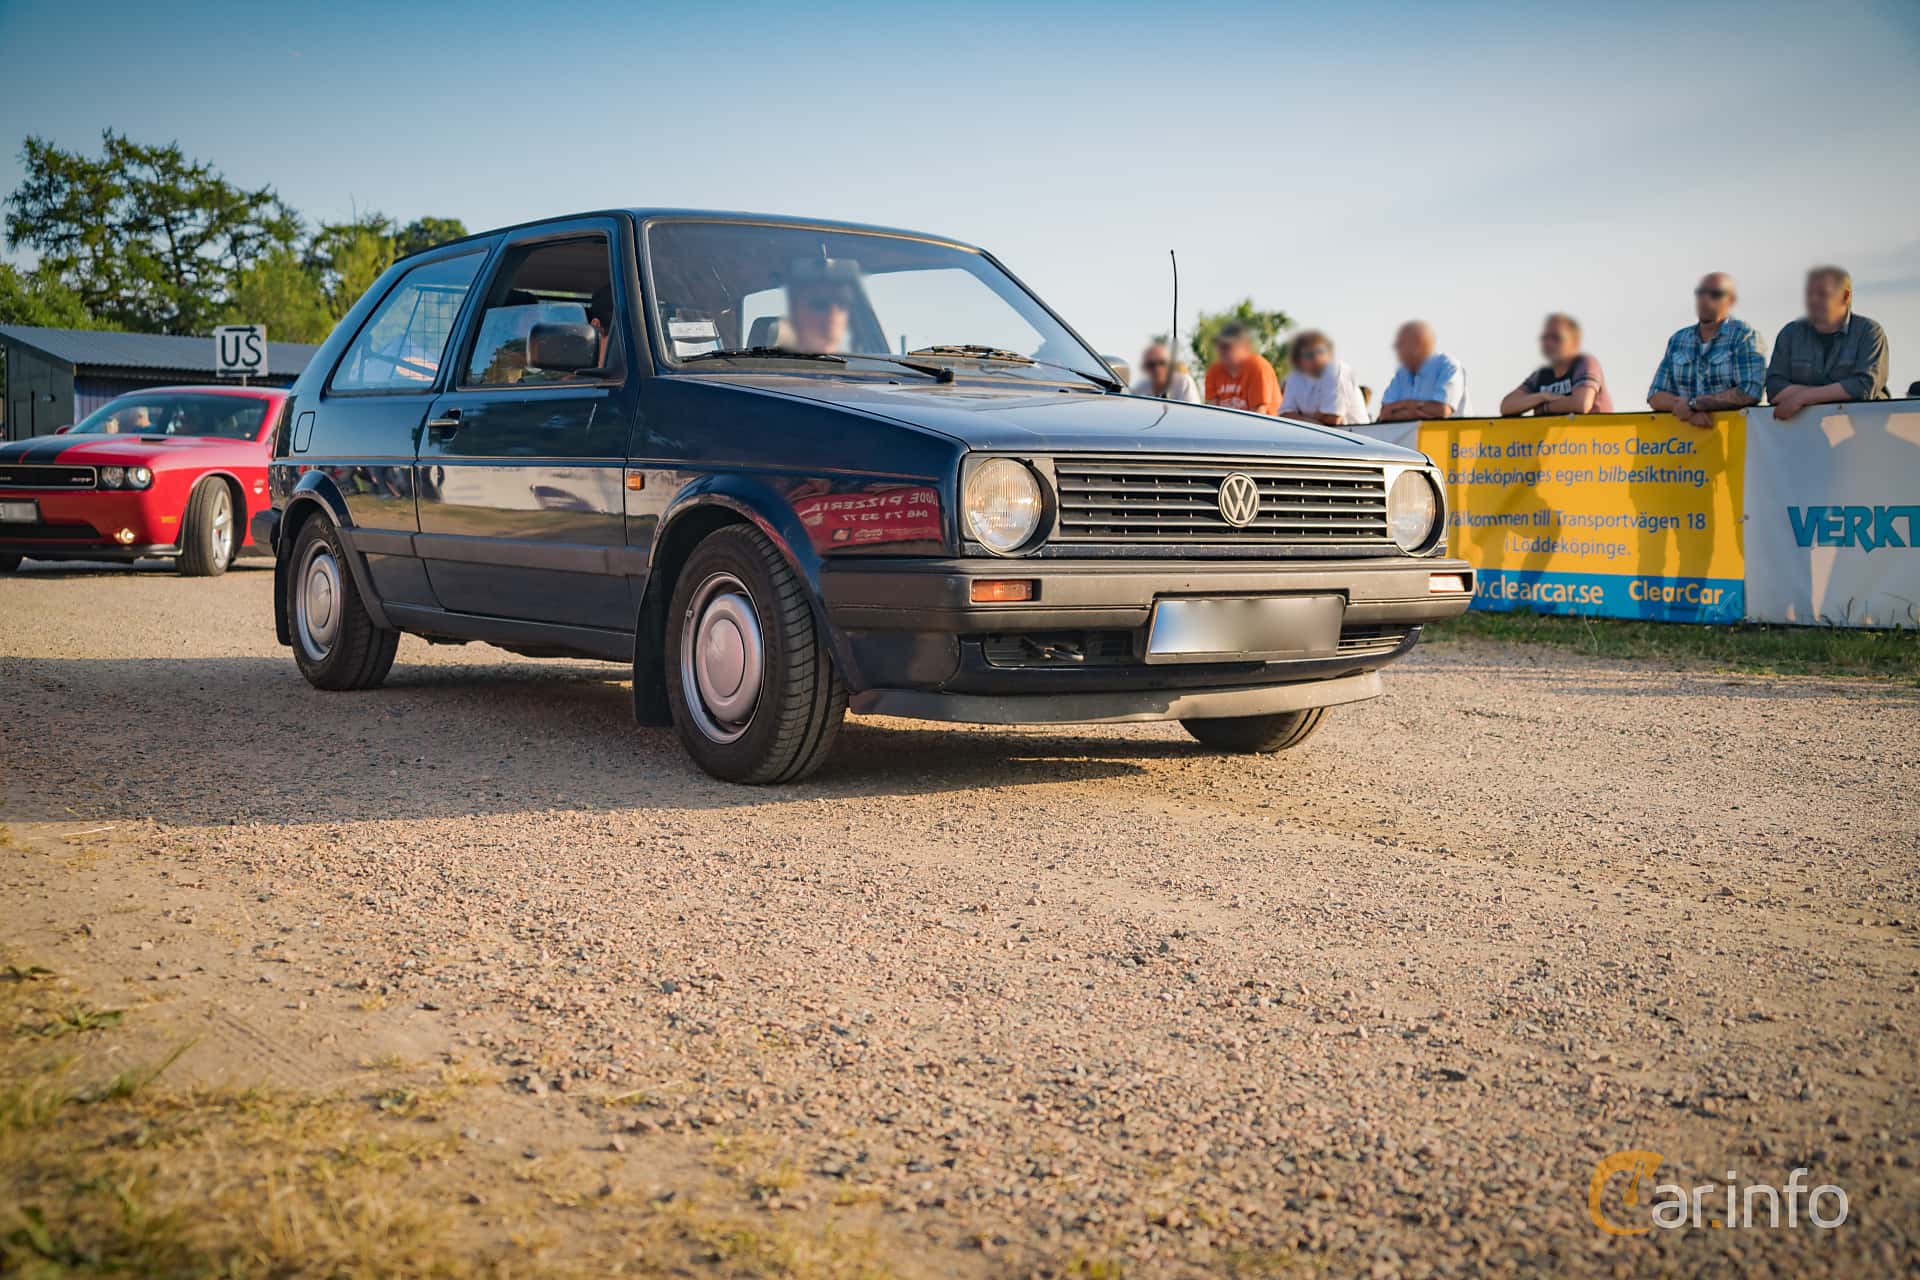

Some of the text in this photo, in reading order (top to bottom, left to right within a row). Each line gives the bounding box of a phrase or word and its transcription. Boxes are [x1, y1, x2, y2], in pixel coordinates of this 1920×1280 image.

[221, 334, 261, 367] US
[1451, 436, 1697, 458] Besikta ditt fordon hos ClearCar.
[1445, 464, 1711, 488] öddeköpinges egen bilbesiktning.
[1532, 509, 1551, 526] till
[1554, 509, 1681, 534] Transportvägen
[1687, 511, 1707, 530] 18
[1512, 535, 1632, 560] Löddeköpinge.
[1628, 578, 1725, 606] ClearCar
